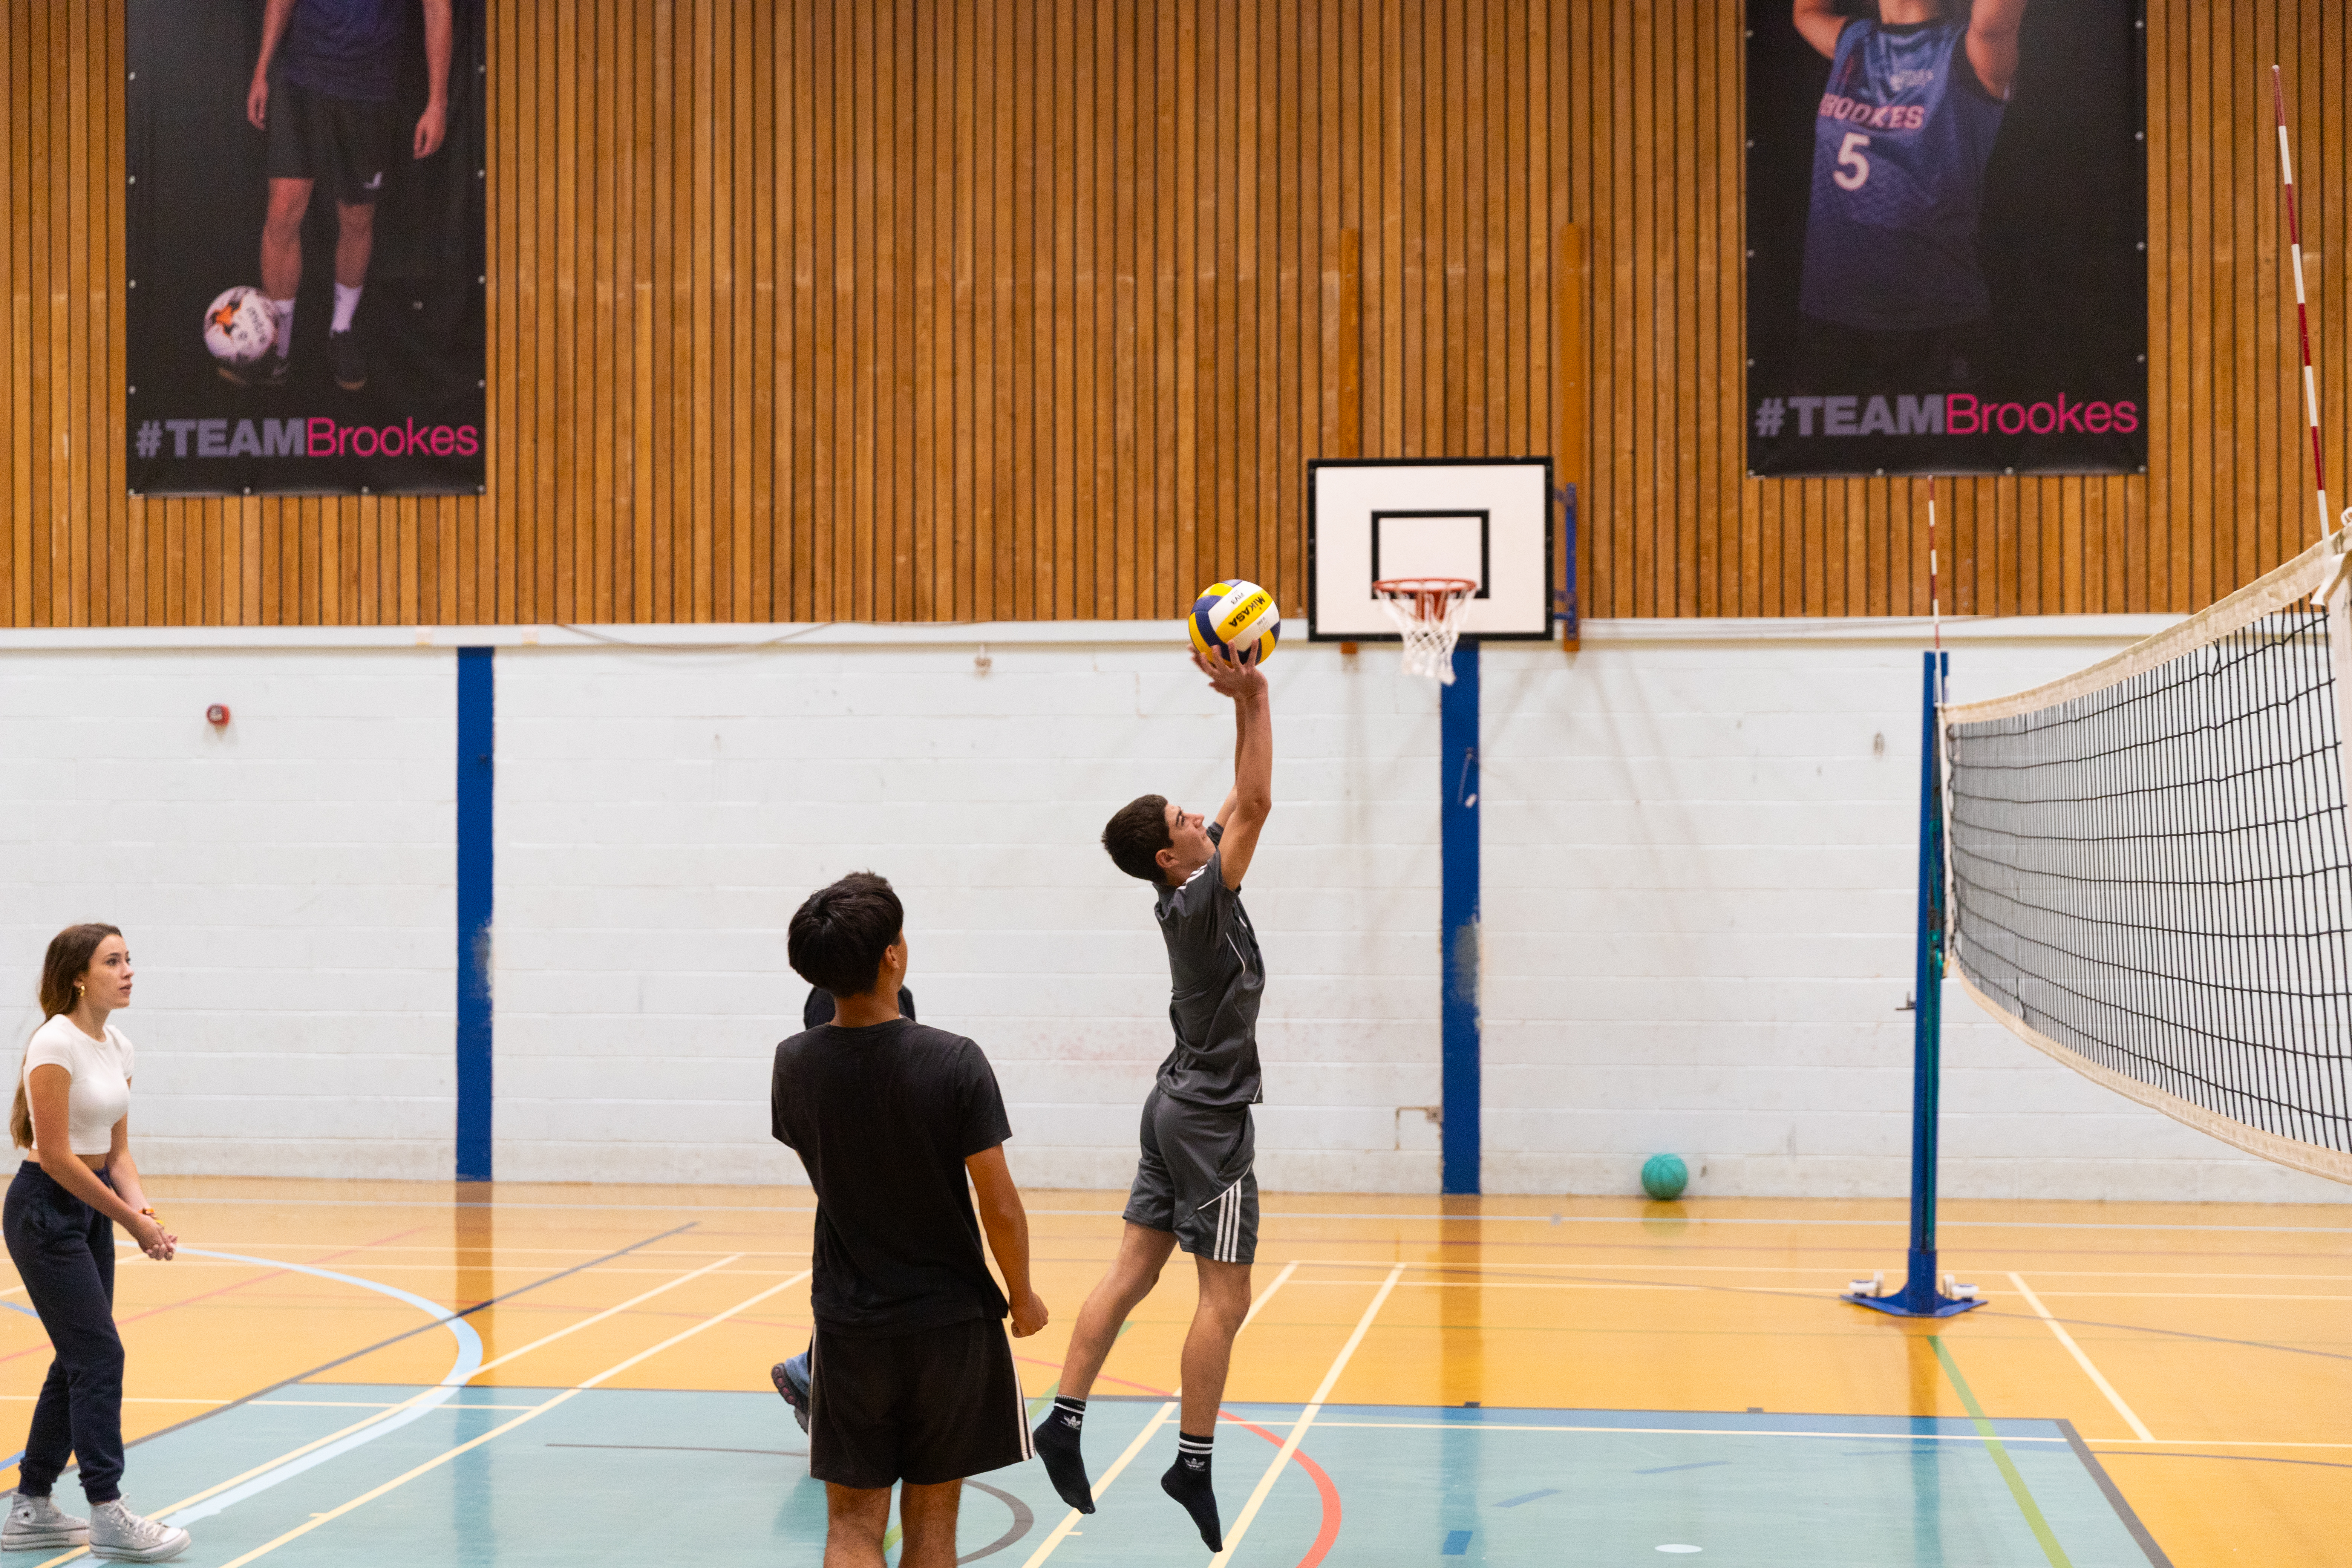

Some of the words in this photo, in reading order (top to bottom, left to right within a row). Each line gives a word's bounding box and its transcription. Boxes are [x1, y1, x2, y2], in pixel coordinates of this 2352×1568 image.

[1833, 132, 1870, 191] 5
[1756, 393, 2138, 436] #TEAMBrookes
[136, 417, 479, 458] #TEAMBrookes
